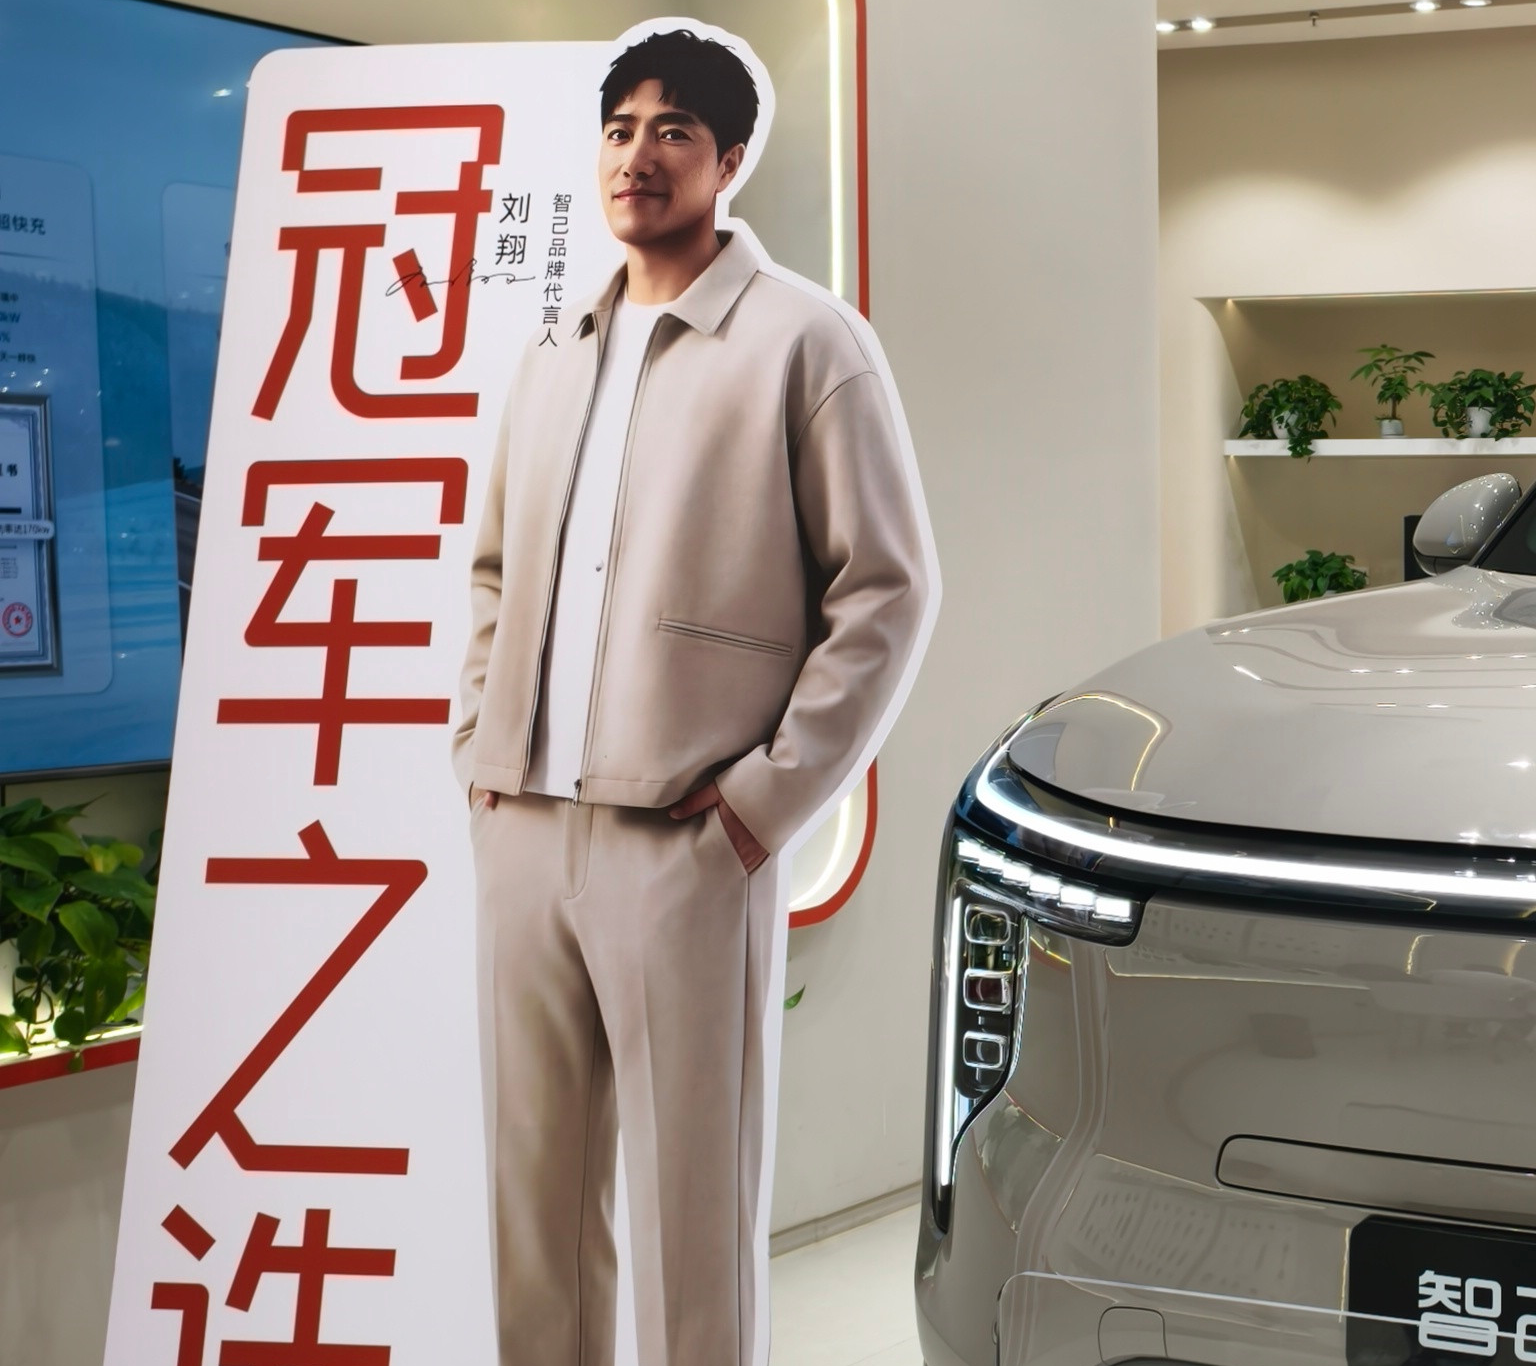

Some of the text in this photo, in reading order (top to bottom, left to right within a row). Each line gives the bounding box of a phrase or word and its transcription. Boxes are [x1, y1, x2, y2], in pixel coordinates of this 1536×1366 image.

[495, 193, 531, 265] 刘翔
[538, 193, 572, 347] 智己品牌代言人
